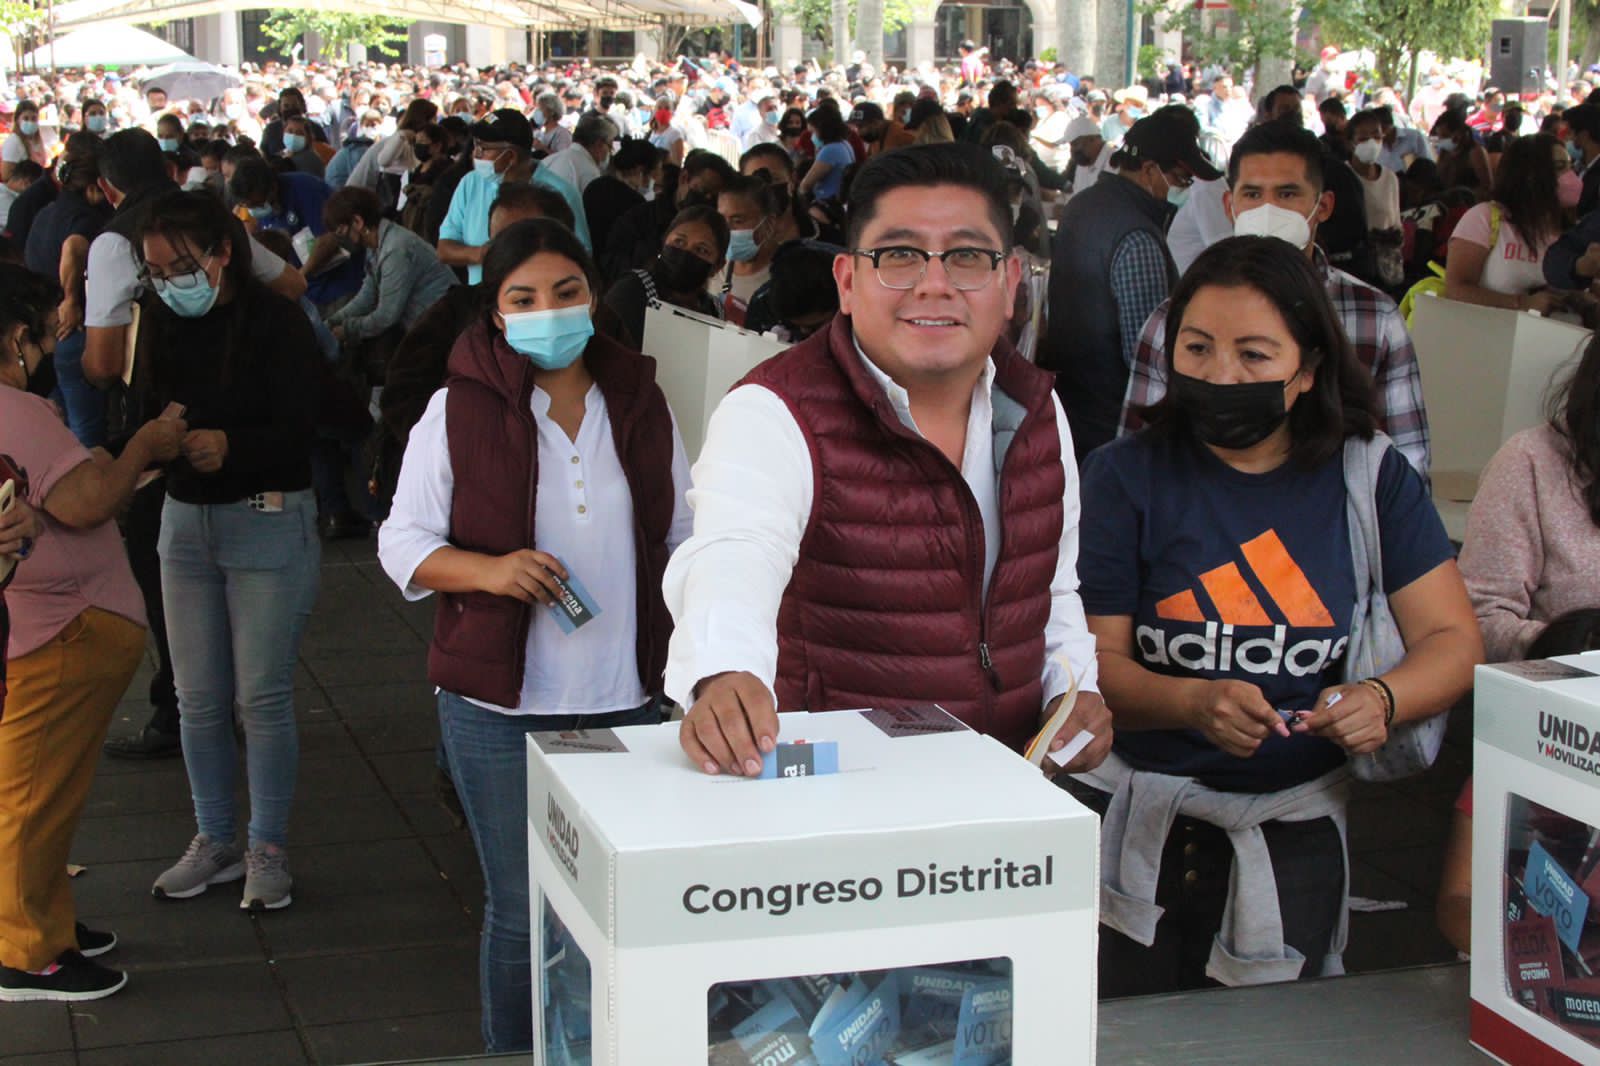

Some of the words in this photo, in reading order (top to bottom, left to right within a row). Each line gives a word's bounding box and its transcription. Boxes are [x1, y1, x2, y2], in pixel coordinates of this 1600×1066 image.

[1537, 739, 1544, 753] Y
[547, 791, 579, 859] UNIDAD
[682, 875, 883, 916] Congreso
[897, 855, 1054, 899] Distrital
[1535, 874, 1573, 929] VOTO
[838, 998, 881, 1044] UNIDAD
